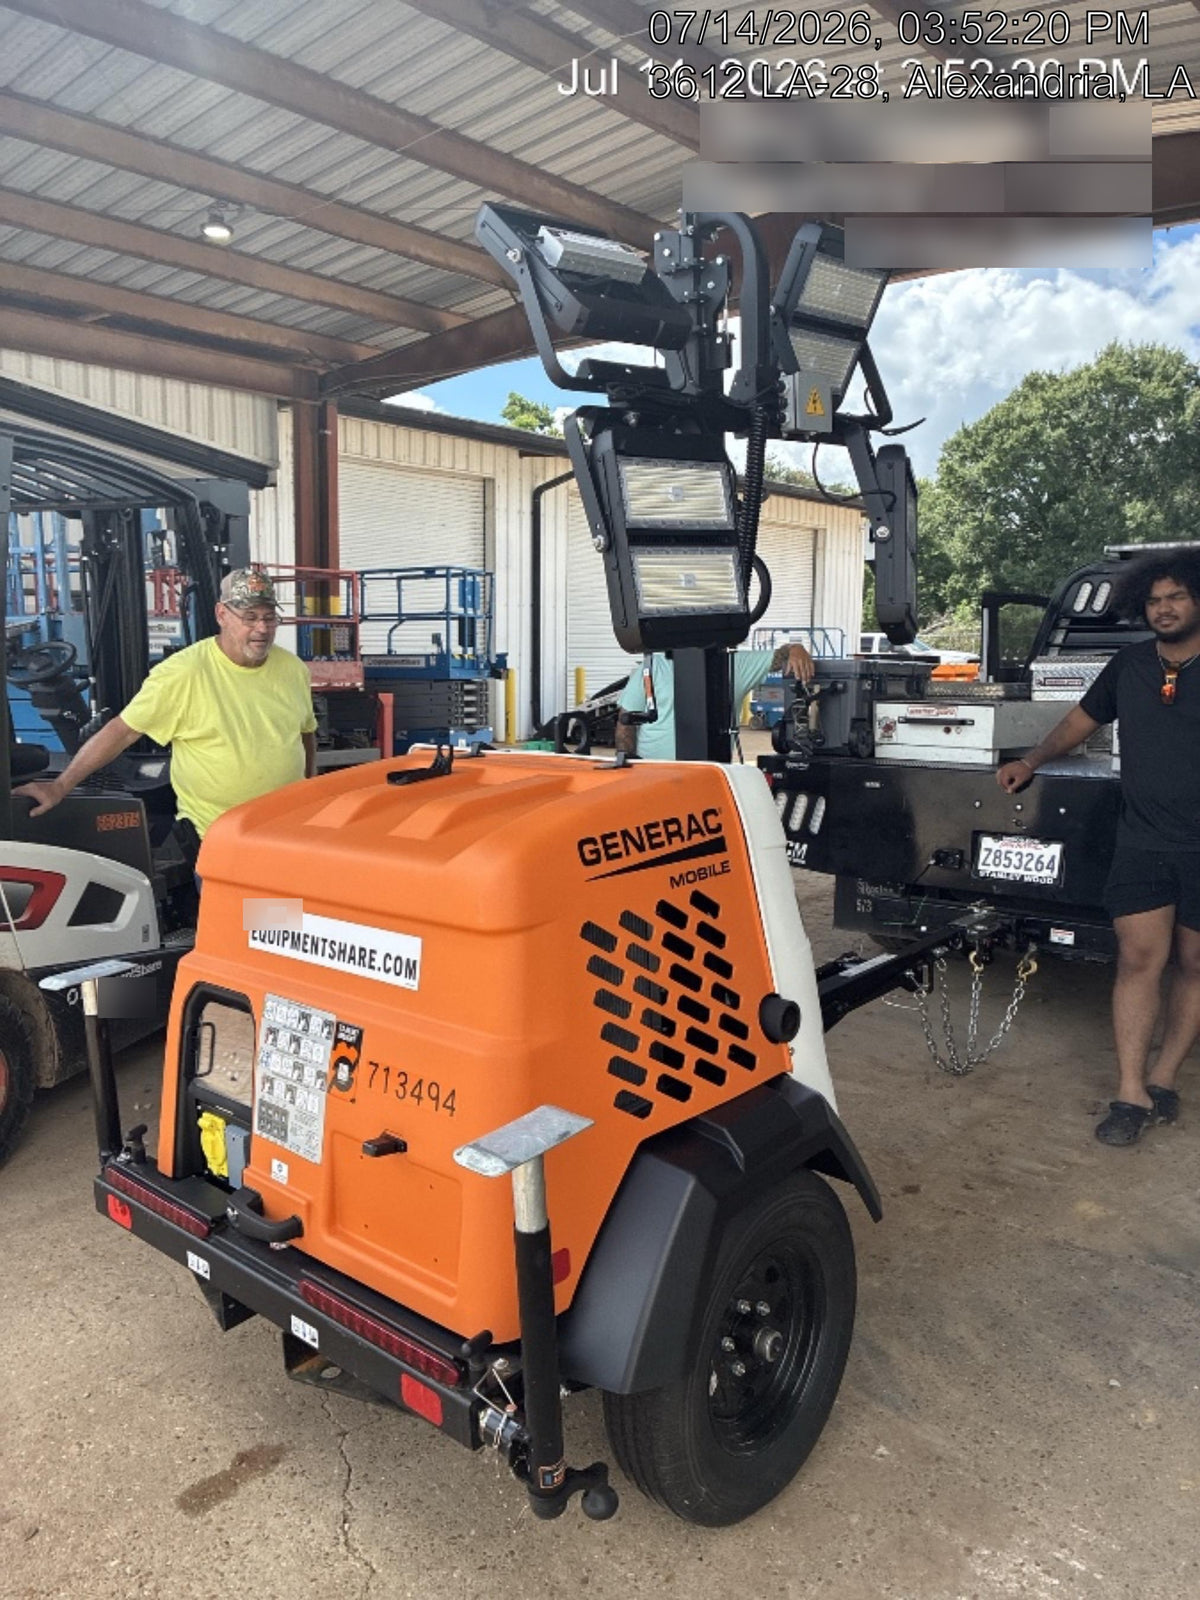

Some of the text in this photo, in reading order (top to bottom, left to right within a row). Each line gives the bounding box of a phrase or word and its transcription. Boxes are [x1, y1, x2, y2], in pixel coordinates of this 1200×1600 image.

[577, 808, 723, 867] GENERAC
[981, 847, 1056, 874] Z853264
[669, 860, 731, 889] MOBILE
[251, 929, 418, 981] EQUIPMENTSHARE.COM
[368, 1061, 457, 1118] 713494
